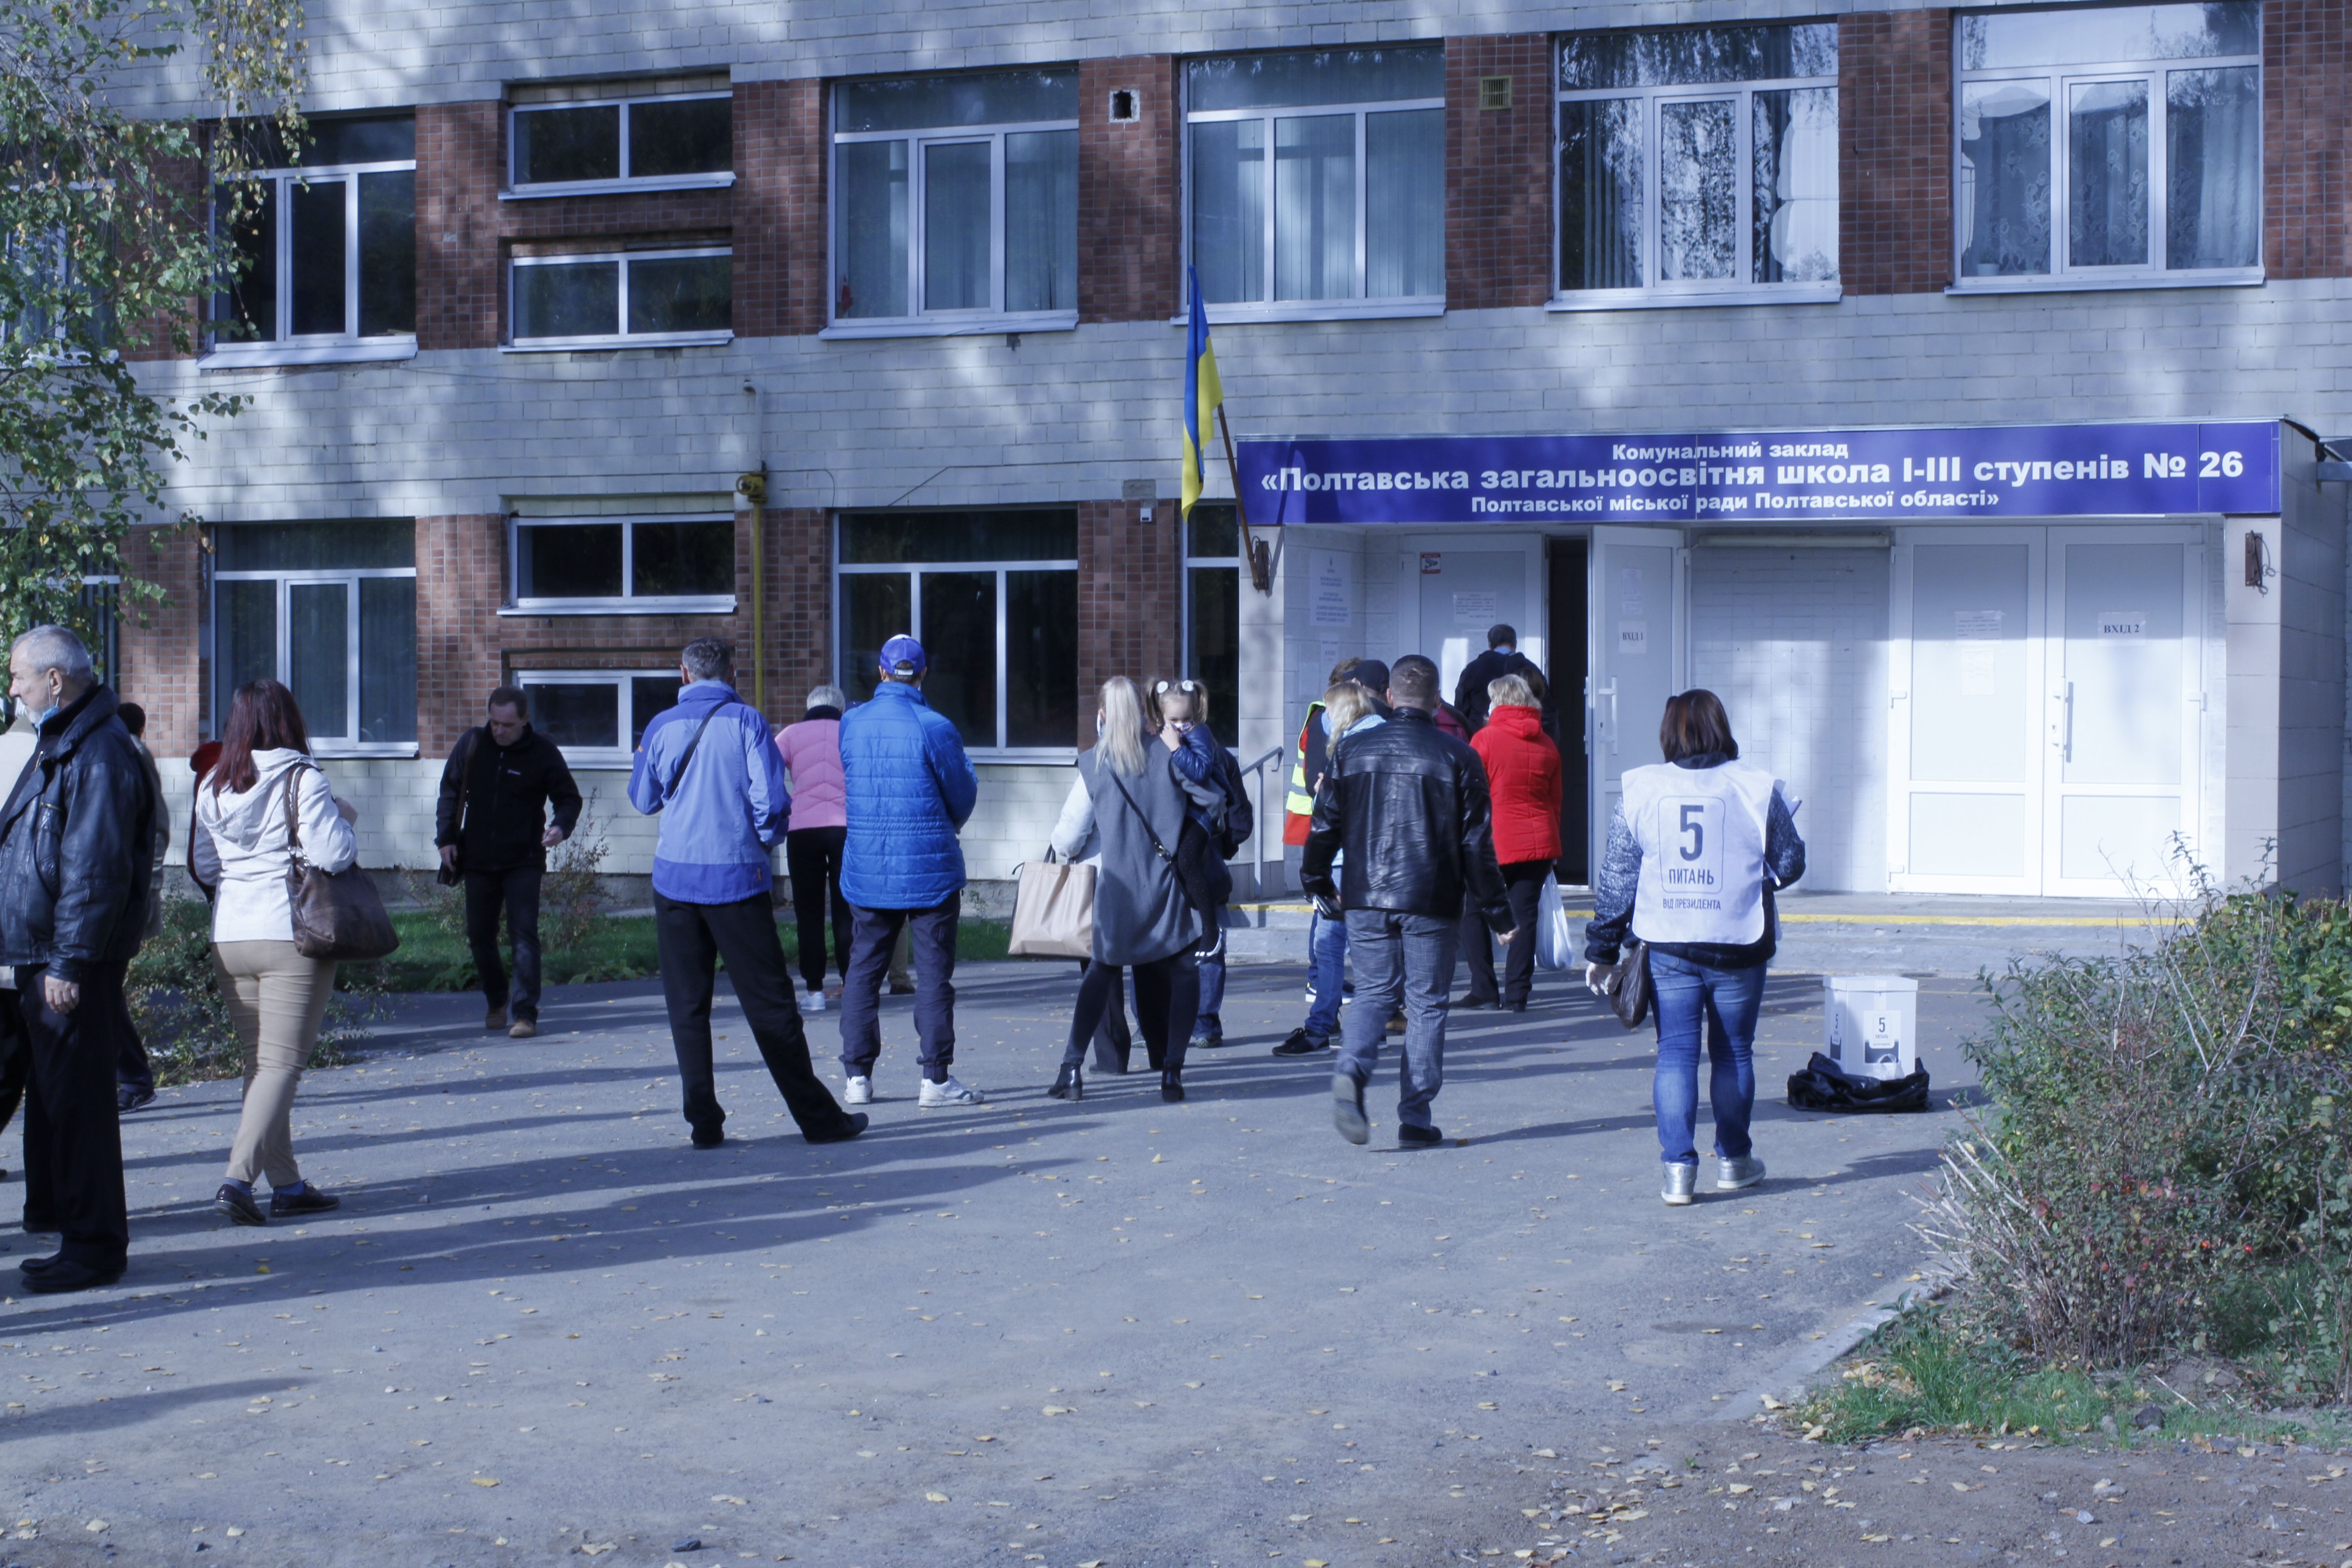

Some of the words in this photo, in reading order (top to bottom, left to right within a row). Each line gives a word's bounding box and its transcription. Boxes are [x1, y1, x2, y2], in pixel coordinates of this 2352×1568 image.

[1612, 441, 1762, 464] Комунальний
[1769, 443, 1848, 459] заклад
[1261, 467, 1469, 491] «Полтавська
[1480, 461, 1765, 489] загальноосвітня
[1777, 463, 1890, 484] школа
[1973, 454, 2130, 487] ступенів
[2144, 452, 2186, 479] №
[2199, 451, 2244, 478] 26
[1471, 495, 1604, 513] Полтавської
[1609, 494, 1688, 512] міської
[1696, 496, 1748, 513] ради
[1755, 491, 1894, 509] Полтавської
[1900, 490, 1999, 506] області»
[1622, 632, 1639, 642] ВХІД
[2104, 624, 2132, 634] ВХІД
[2134, 624, 2140, 633] 2
[1680, 805, 1704, 861] 5
[1669, 868, 1715, 885] ПИТАНЬ
[1663, 898, 1674, 910] ВІД
[1675, 898, 1721, 911] ПРЕЗИДЕНТА
[1879, 1017, 1885, 1033] 5
